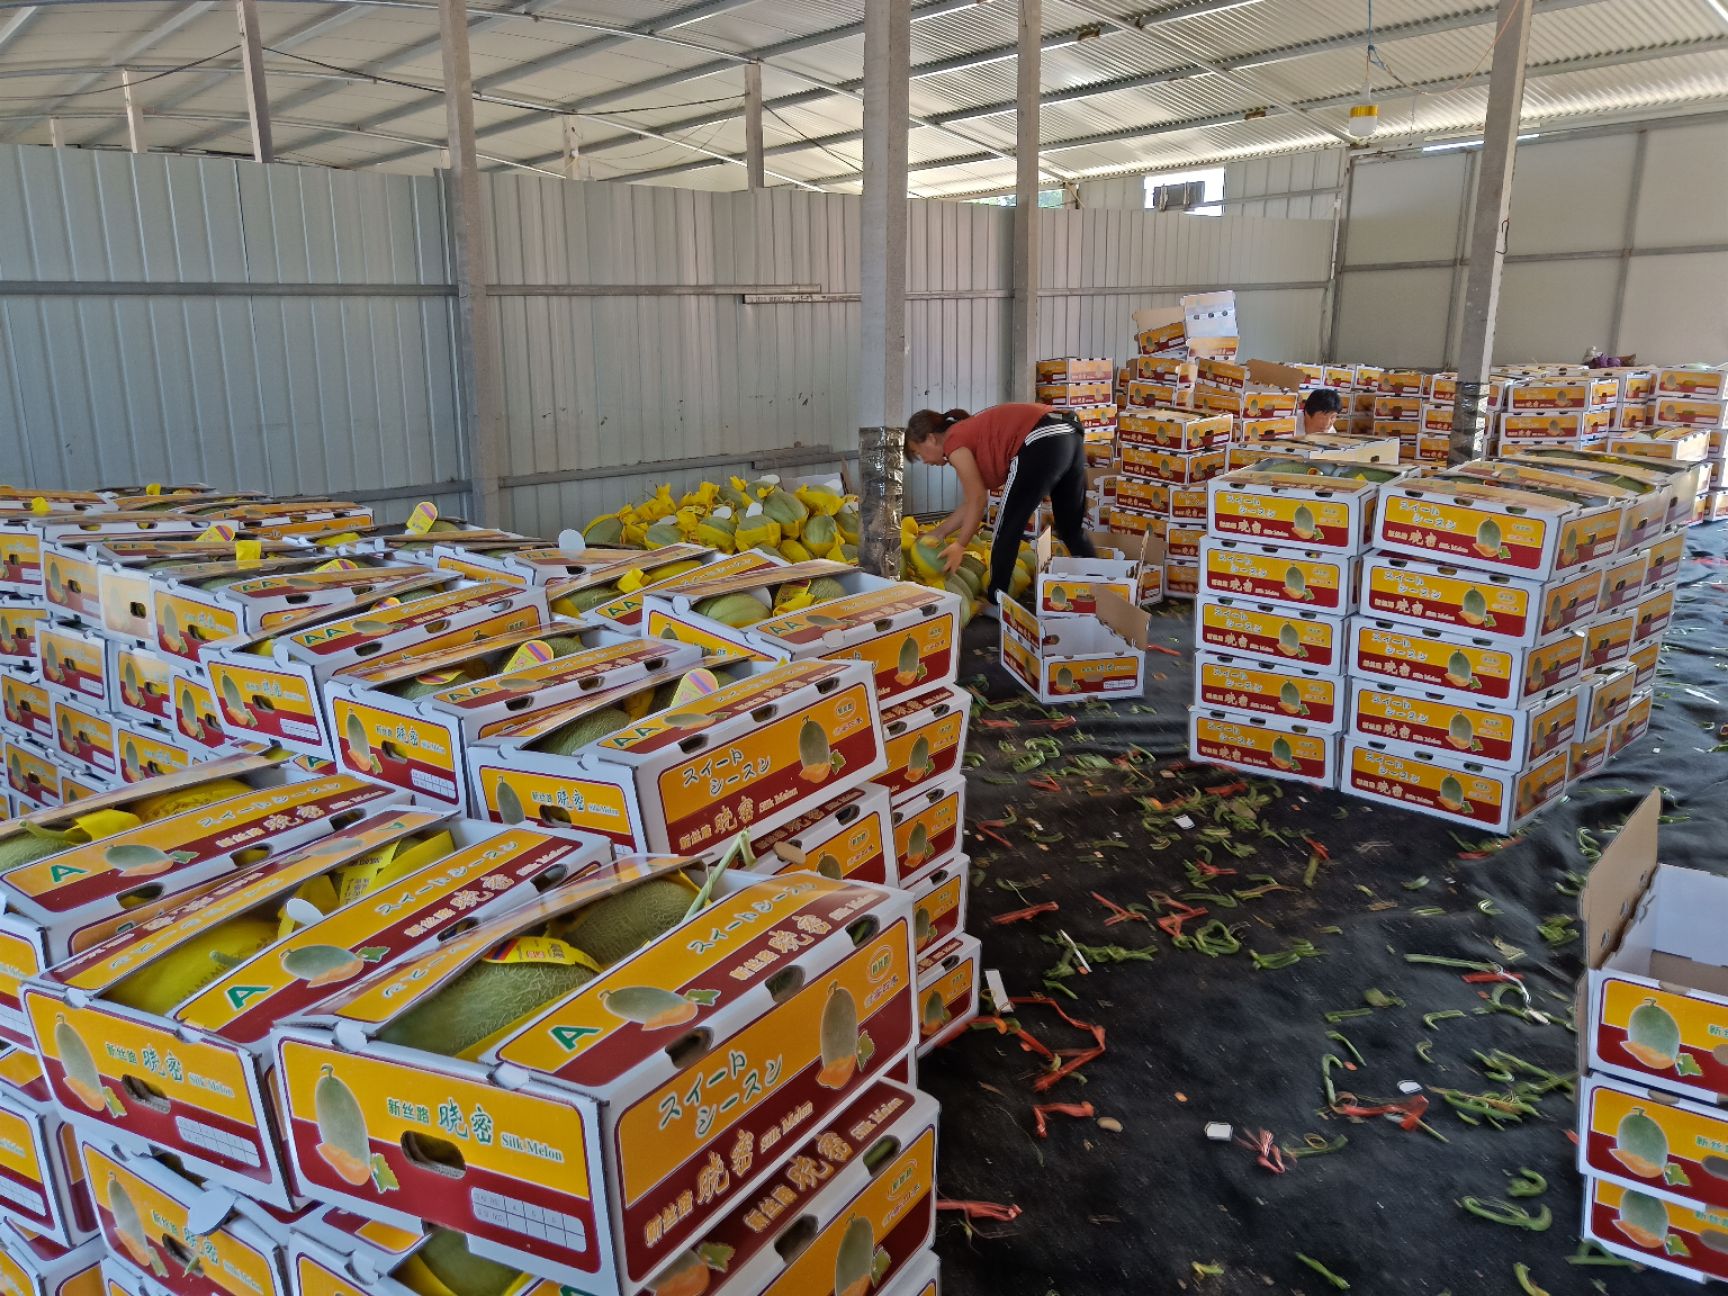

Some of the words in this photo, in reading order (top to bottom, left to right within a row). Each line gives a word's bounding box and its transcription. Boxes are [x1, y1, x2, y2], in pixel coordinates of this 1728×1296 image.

[607, 600, 640, 618] AA
[304, 628, 346, 645] AA
[769, 619, 804, 636] AA
[448, 686, 492, 701] AA
[612, 727, 662, 748] AA
[50, 864, 88, 883] A
[226, 985, 273, 1010] A
[548, 1025, 602, 1052] A
[142, 1043, 183, 1083] 晓密
[660, 1051, 746, 1130] スイート
[387, 1098, 430, 1124] 新丝路
[438, 1098, 493, 1144] 晓密
[501, 1132, 523, 1152] Silk
[525, 1138, 564, 1162] Melon
